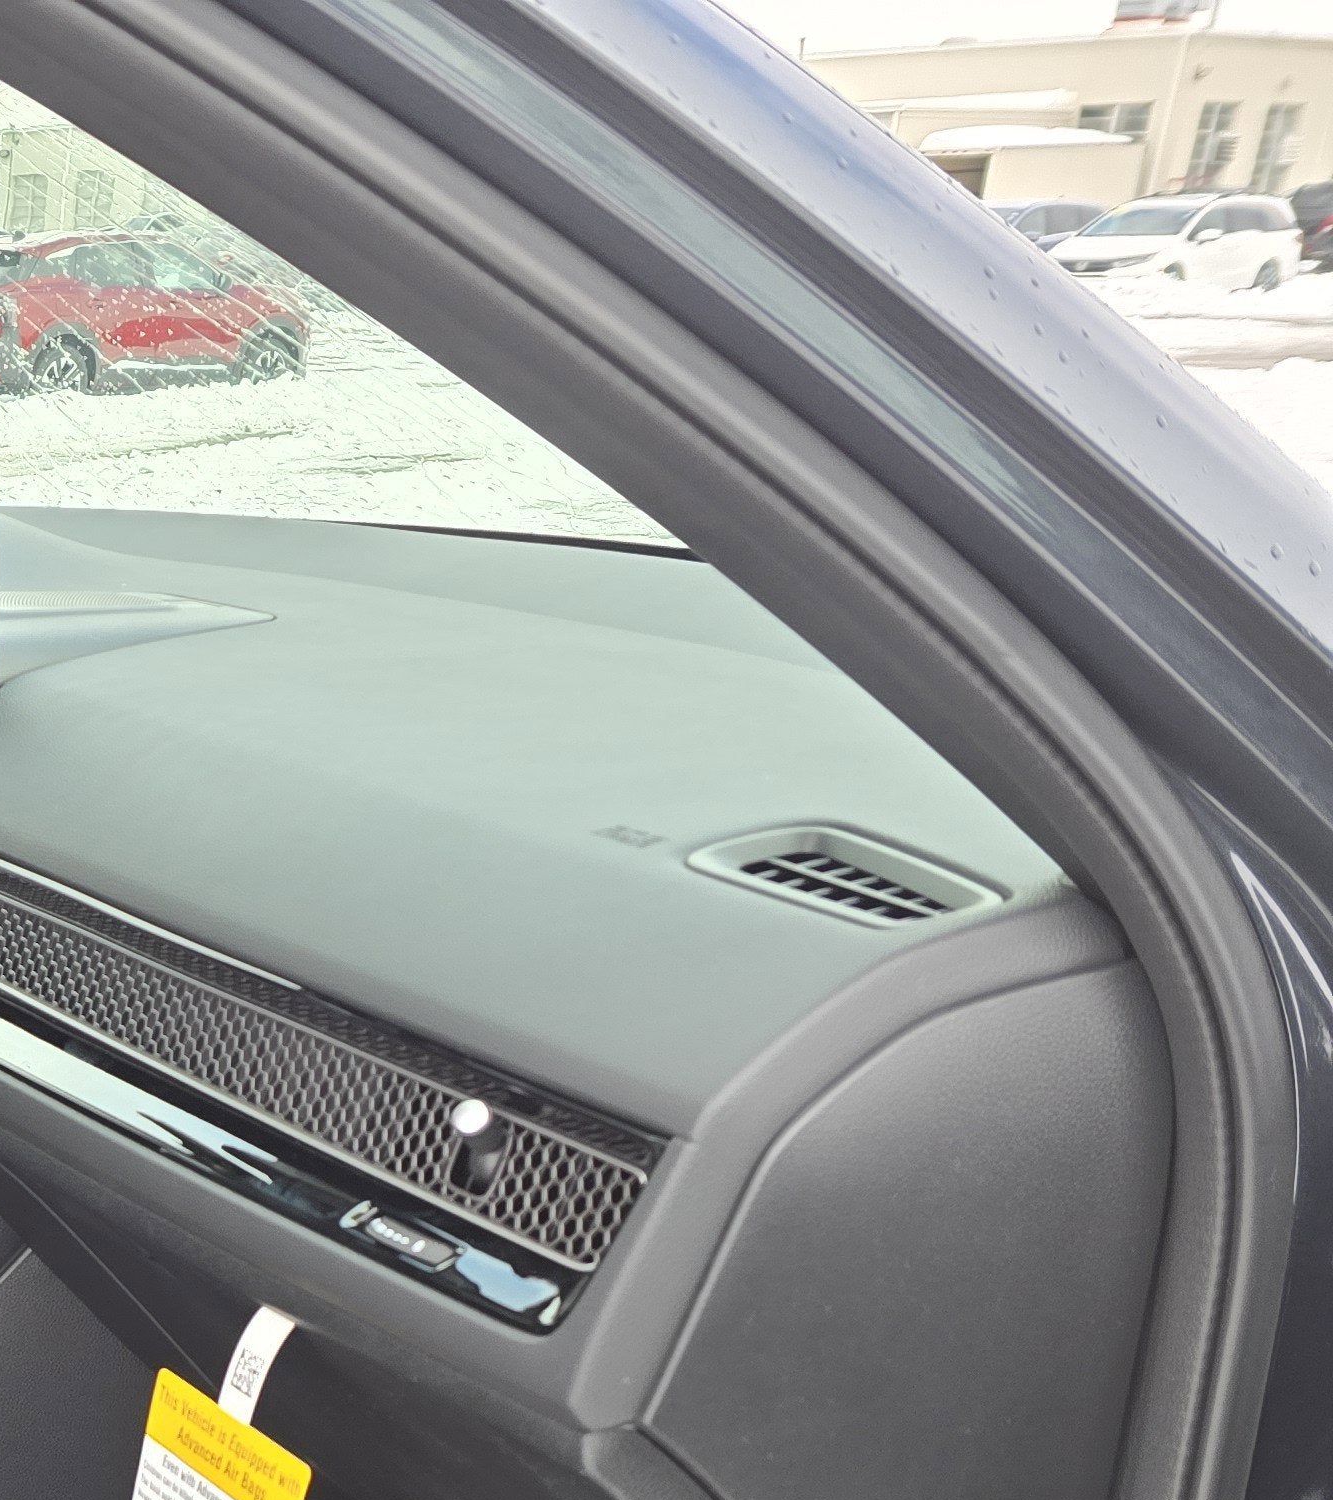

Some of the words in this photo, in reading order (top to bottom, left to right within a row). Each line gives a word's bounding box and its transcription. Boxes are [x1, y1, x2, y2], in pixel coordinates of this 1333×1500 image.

[158, 1383, 179, 1412] This
[179, 1397, 216, 1437] Vehicle
[217, 1425, 228, 1445] is
[227, 1431, 277, 1483] Equipped
[277, 1468, 301, 1498] with
[176, 1424, 223, 1471] Advanced
[223, 1457, 240, 1483] Air
[162, 1453, 180, 1477] Even
[179, 1466, 196, 1489] with
